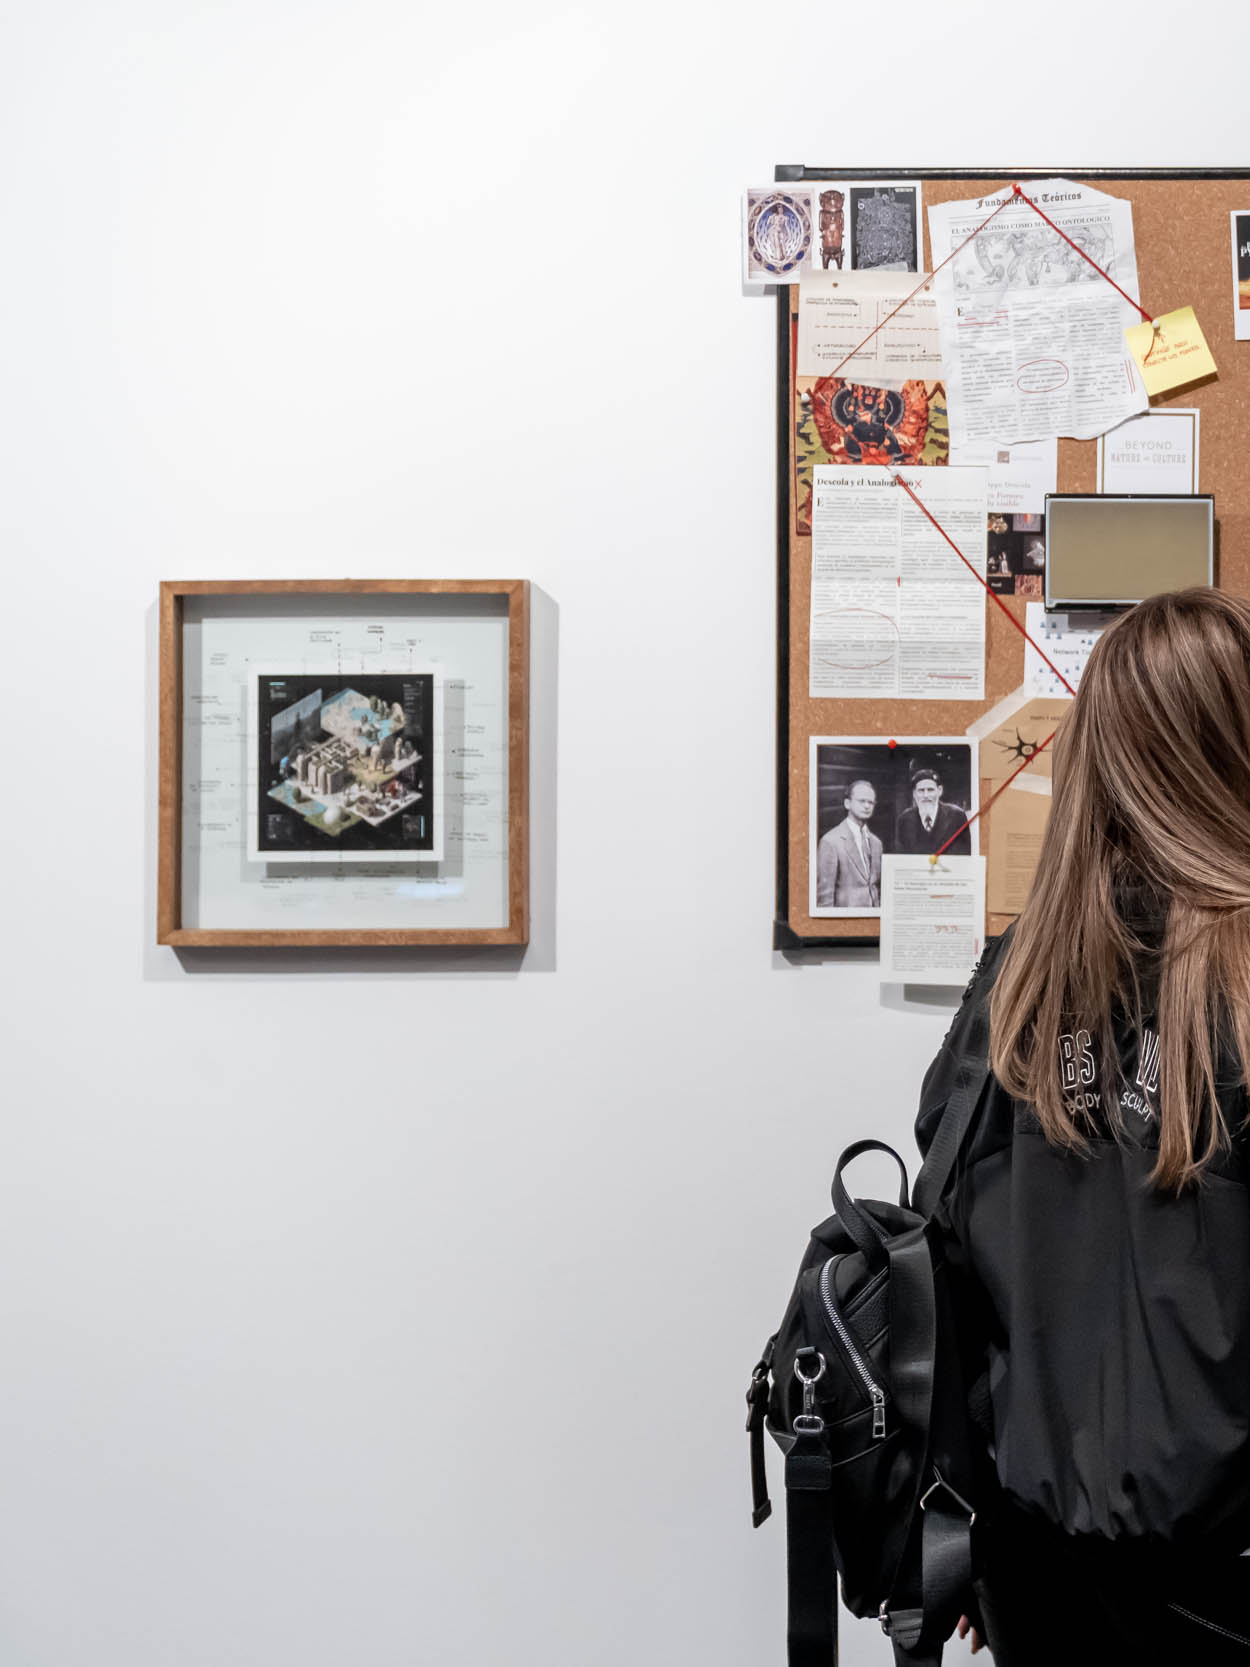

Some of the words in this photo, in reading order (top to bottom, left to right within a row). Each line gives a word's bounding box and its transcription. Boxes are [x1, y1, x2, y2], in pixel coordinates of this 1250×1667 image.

[1124, 439, 1173, 450] BEYOND
[817, 478, 849, 486] Descola
[866, 478, 914, 488] Analogmo
[1057, 1029, 1096, 1090] BS
[1064, 1093, 1101, 1115] BODY
[1120, 1091, 1152, 1123] SCULPT
